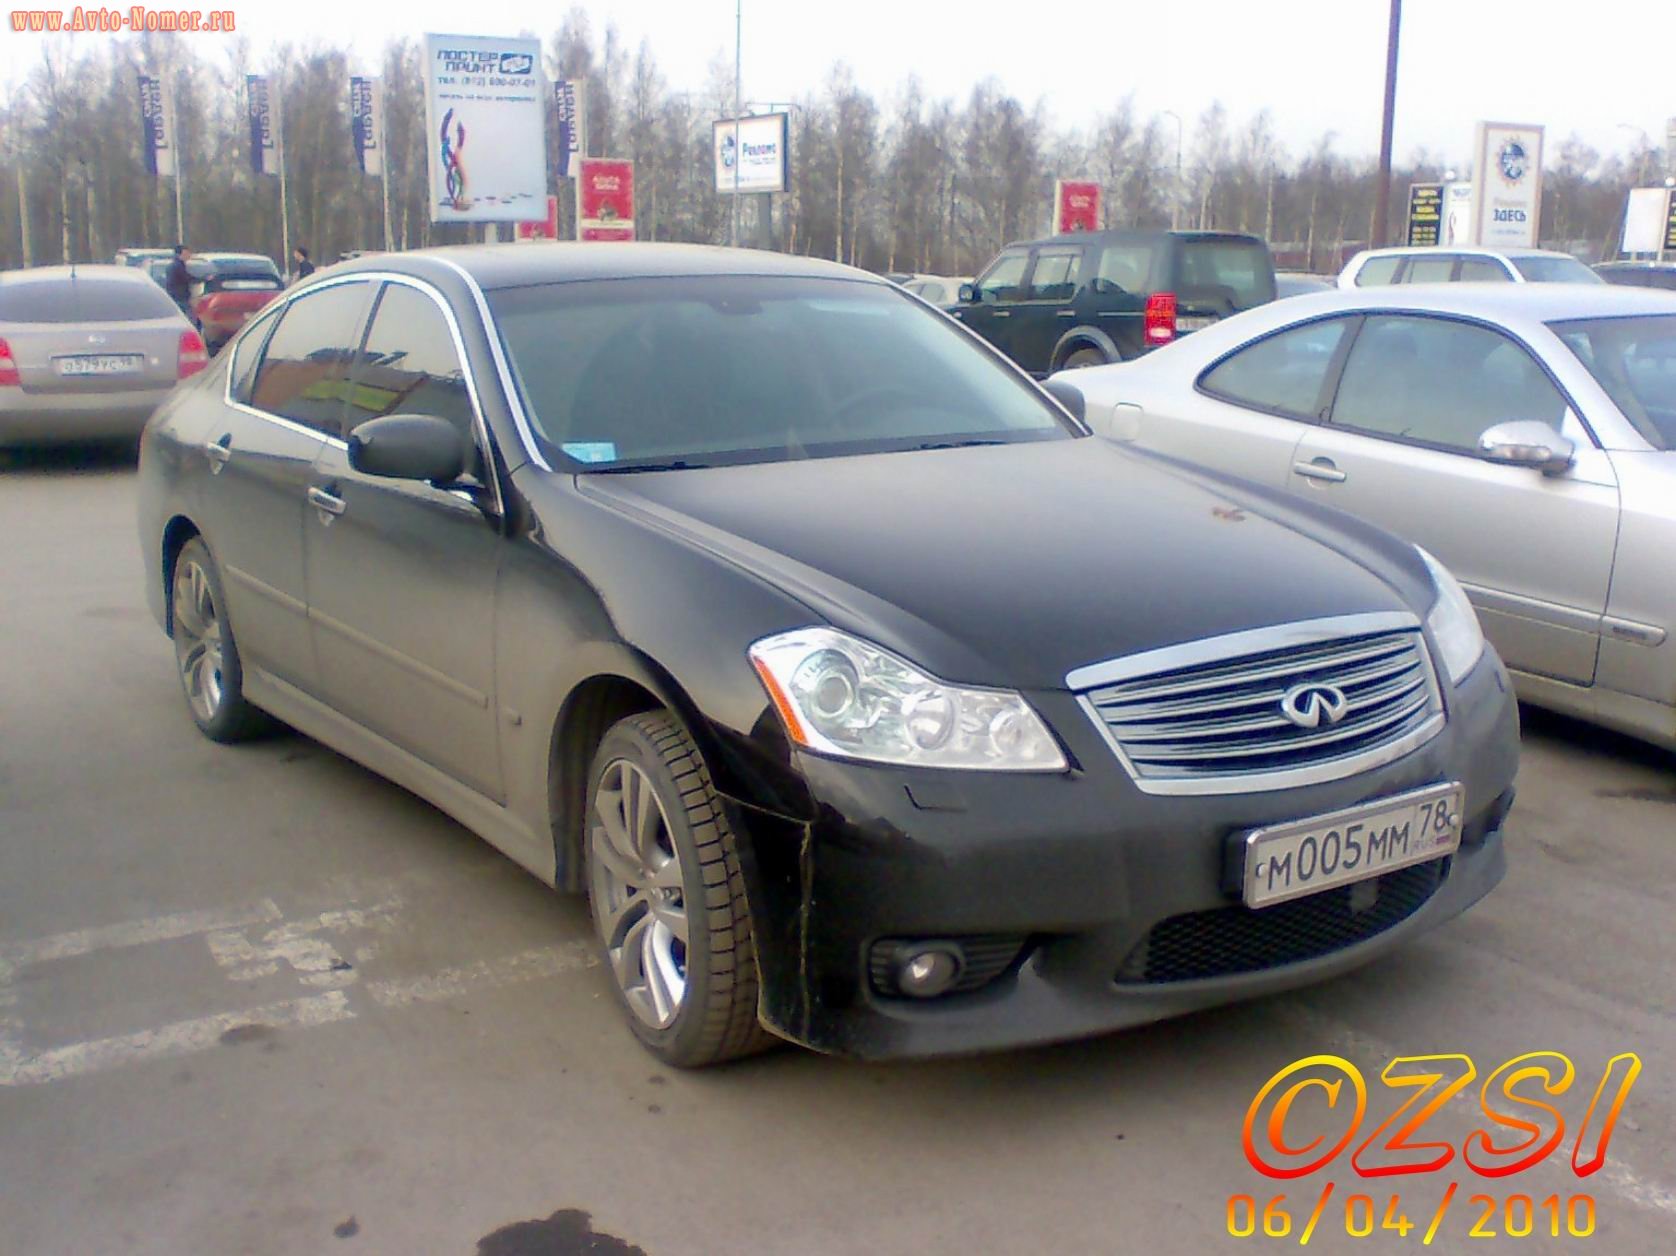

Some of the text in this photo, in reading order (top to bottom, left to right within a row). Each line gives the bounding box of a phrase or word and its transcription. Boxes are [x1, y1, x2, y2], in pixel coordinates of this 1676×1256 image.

[1493, 208, 1527, 222] ЗДЕСЬ
[1267, 799, 1447, 890] М005ММ 78
